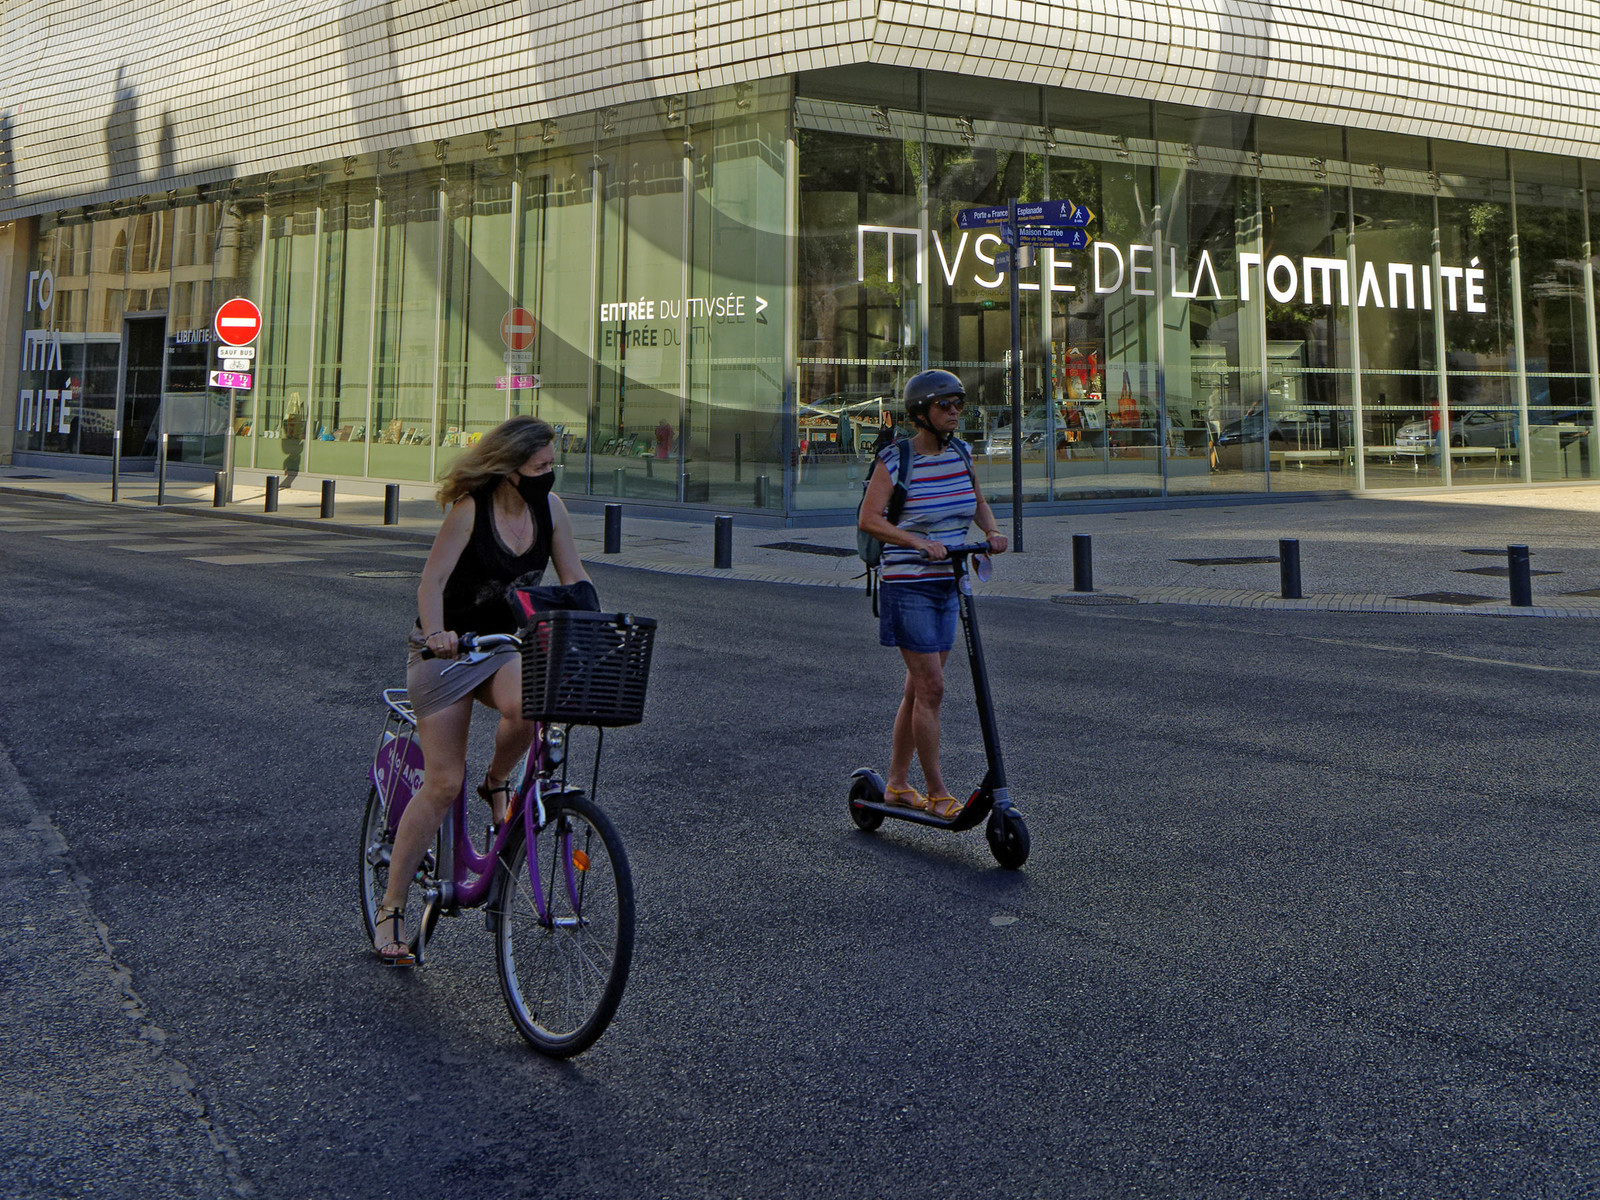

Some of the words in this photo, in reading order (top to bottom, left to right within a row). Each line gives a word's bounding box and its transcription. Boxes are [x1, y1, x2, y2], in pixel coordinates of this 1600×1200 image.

[973, 211, 987, 220] Porte
[991, 209, 1009, 218] France
[1017, 206, 1043, 216] Esplanade
[1019, 228, 1042, 236] Maison
[1042, 228, 1064, 237] Carrée
[1094, 241, 1155, 296] DE
[1170, 247, 1222, 300] LA
[600, 296, 655, 322] ENTRÉE
[660, 299, 681, 320] DU
